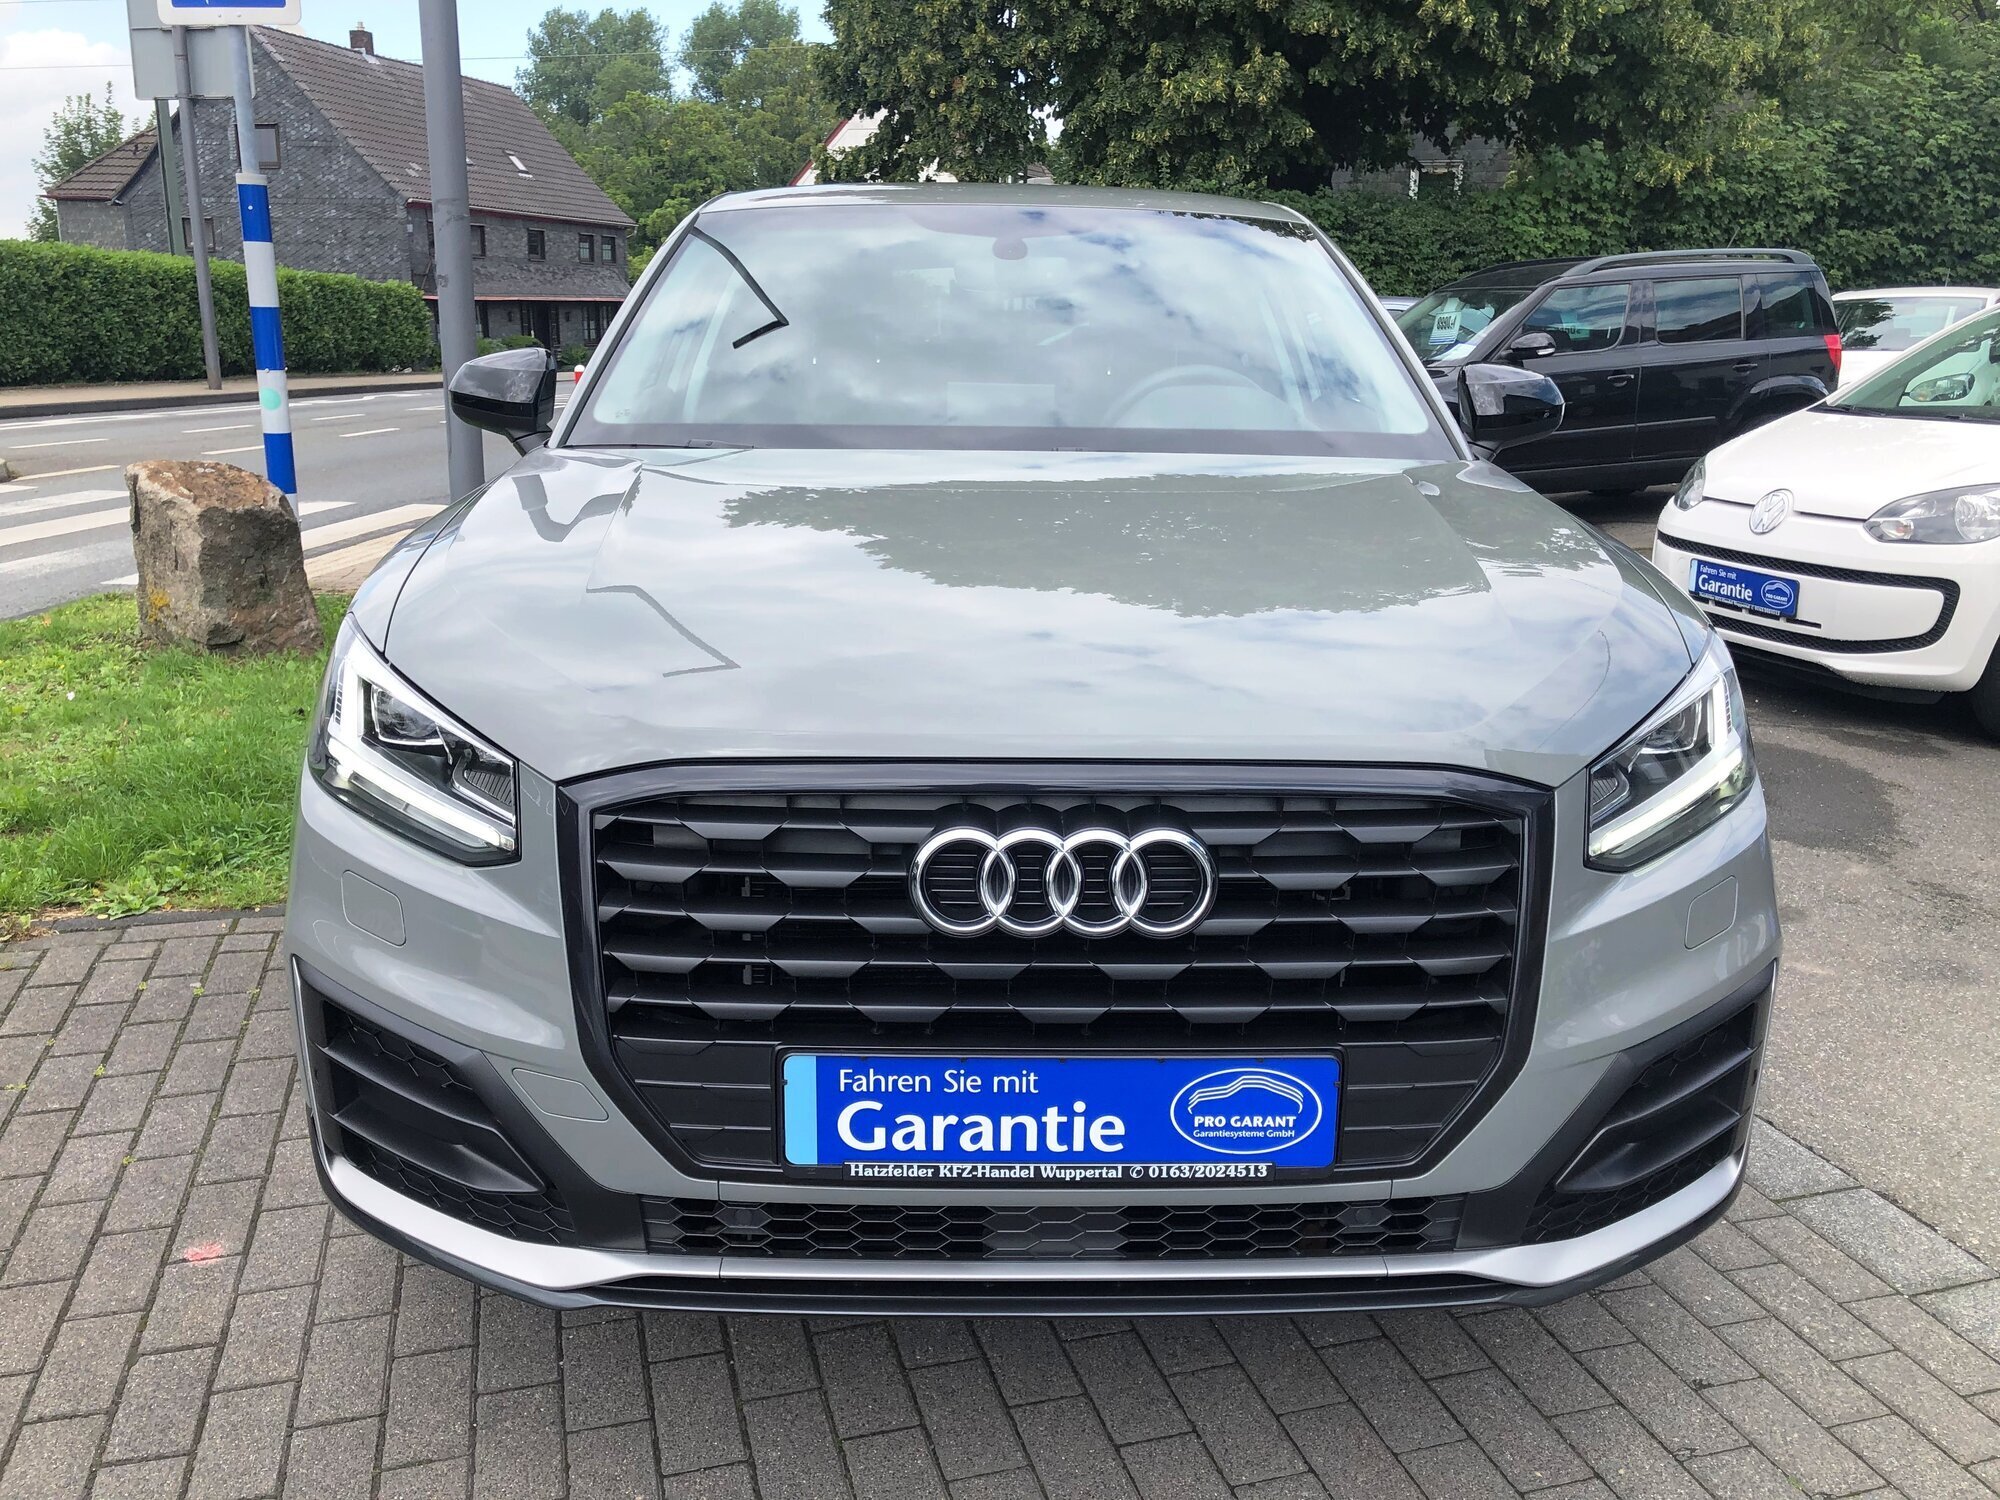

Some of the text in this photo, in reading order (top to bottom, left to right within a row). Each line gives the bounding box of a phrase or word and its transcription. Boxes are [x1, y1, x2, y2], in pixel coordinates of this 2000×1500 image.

[1700, 564, 1737, 580] Fahren Sie mit
[1698, 574, 1753, 601] Garantie
[839, 1068, 1039, 1094] Fahren Sie mit
[837, 1100, 1126, 1153] Garantie
[1194, 1115, 1297, 1128] PRO GARANT
[1193, 1129, 1295, 1140] Garantiesysteme GmbH
[850, 1163, 1268, 1181] Hatzfelder KFZ-Handel Wuppertal 0163/2024513
